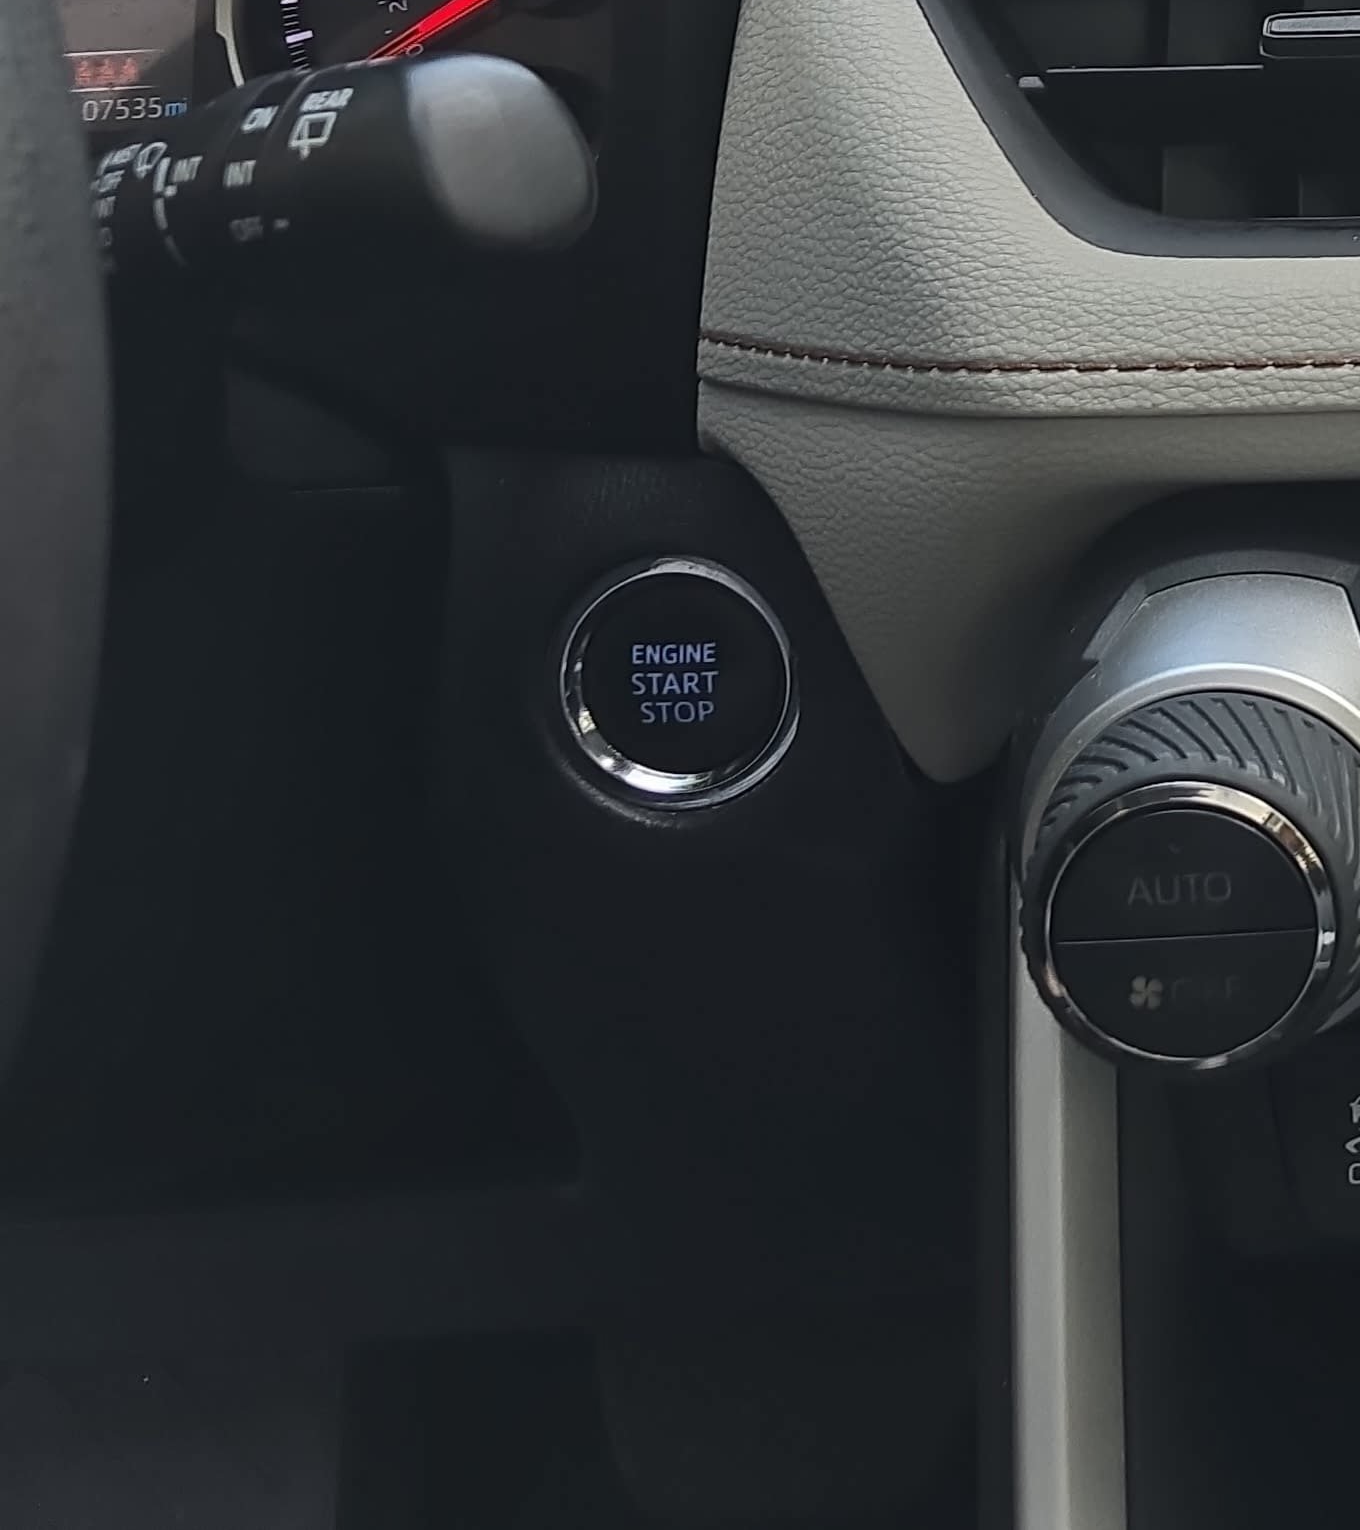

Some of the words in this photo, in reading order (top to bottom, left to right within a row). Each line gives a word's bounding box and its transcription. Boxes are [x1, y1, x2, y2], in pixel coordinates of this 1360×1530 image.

[300, 87, 354, 112] REAR
[241, 106, 279, 132] ON
[632, 642, 716, 665] ENGINE
[631, 670, 719, 695] START
[640, 700, 714, 724] STOP
[1127, 871, 1232, 906] AUTO
